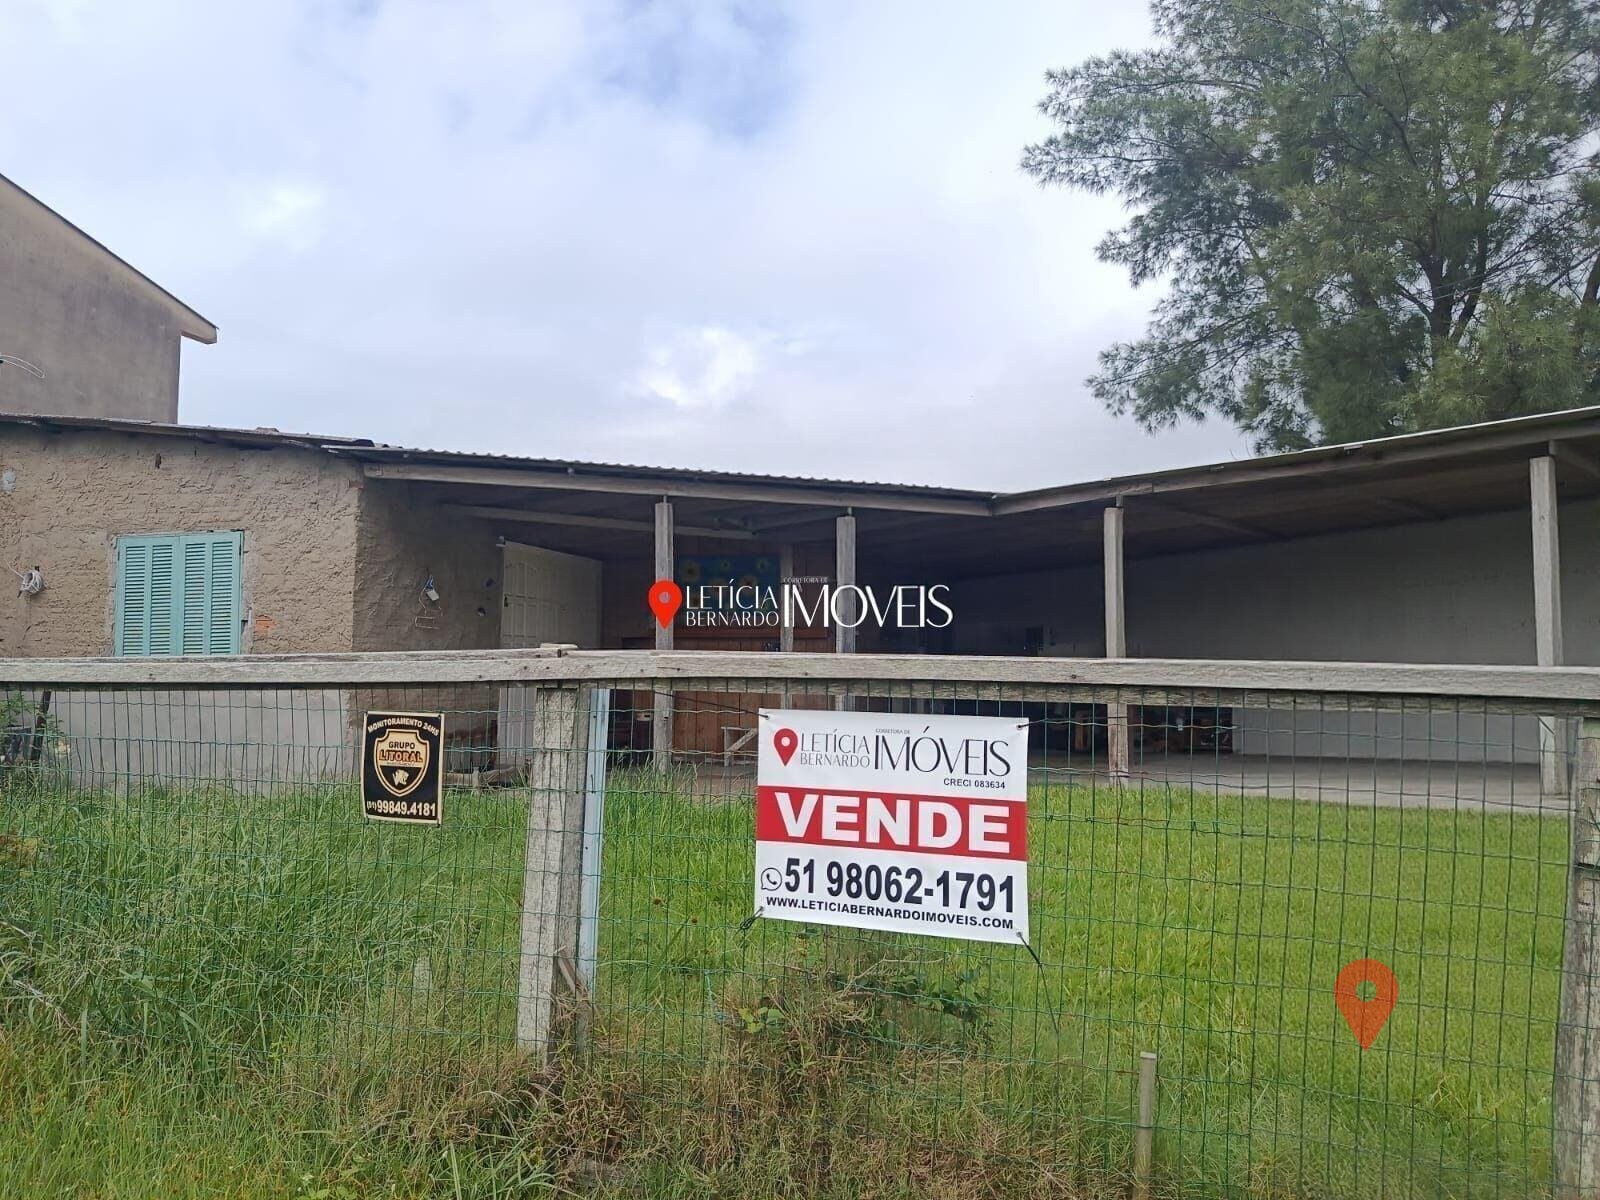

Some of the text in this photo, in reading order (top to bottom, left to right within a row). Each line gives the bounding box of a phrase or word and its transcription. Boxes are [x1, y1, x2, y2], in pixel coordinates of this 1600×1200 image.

[367, 717, 440, 736] MONITORAMENTO 24HS
[388, 741, 416, 749] GRUPO
[800, 728, 870, 755] LETÍCIA
[874, 726, 1011, 777] IMÓVEIS
[379, 750, 423, 763] LITORAL
[800, 752, 870, 769] BERNARDO
[943, 778, 1006, 790] CRECI 083634
[774, 791, 1010, 853] VENDE
[785, 857, 1014, 913] 51 98062-1791
[766, 896, 1014, 930] WWW.LETICIABERNARDOIMOVEIS.COM
